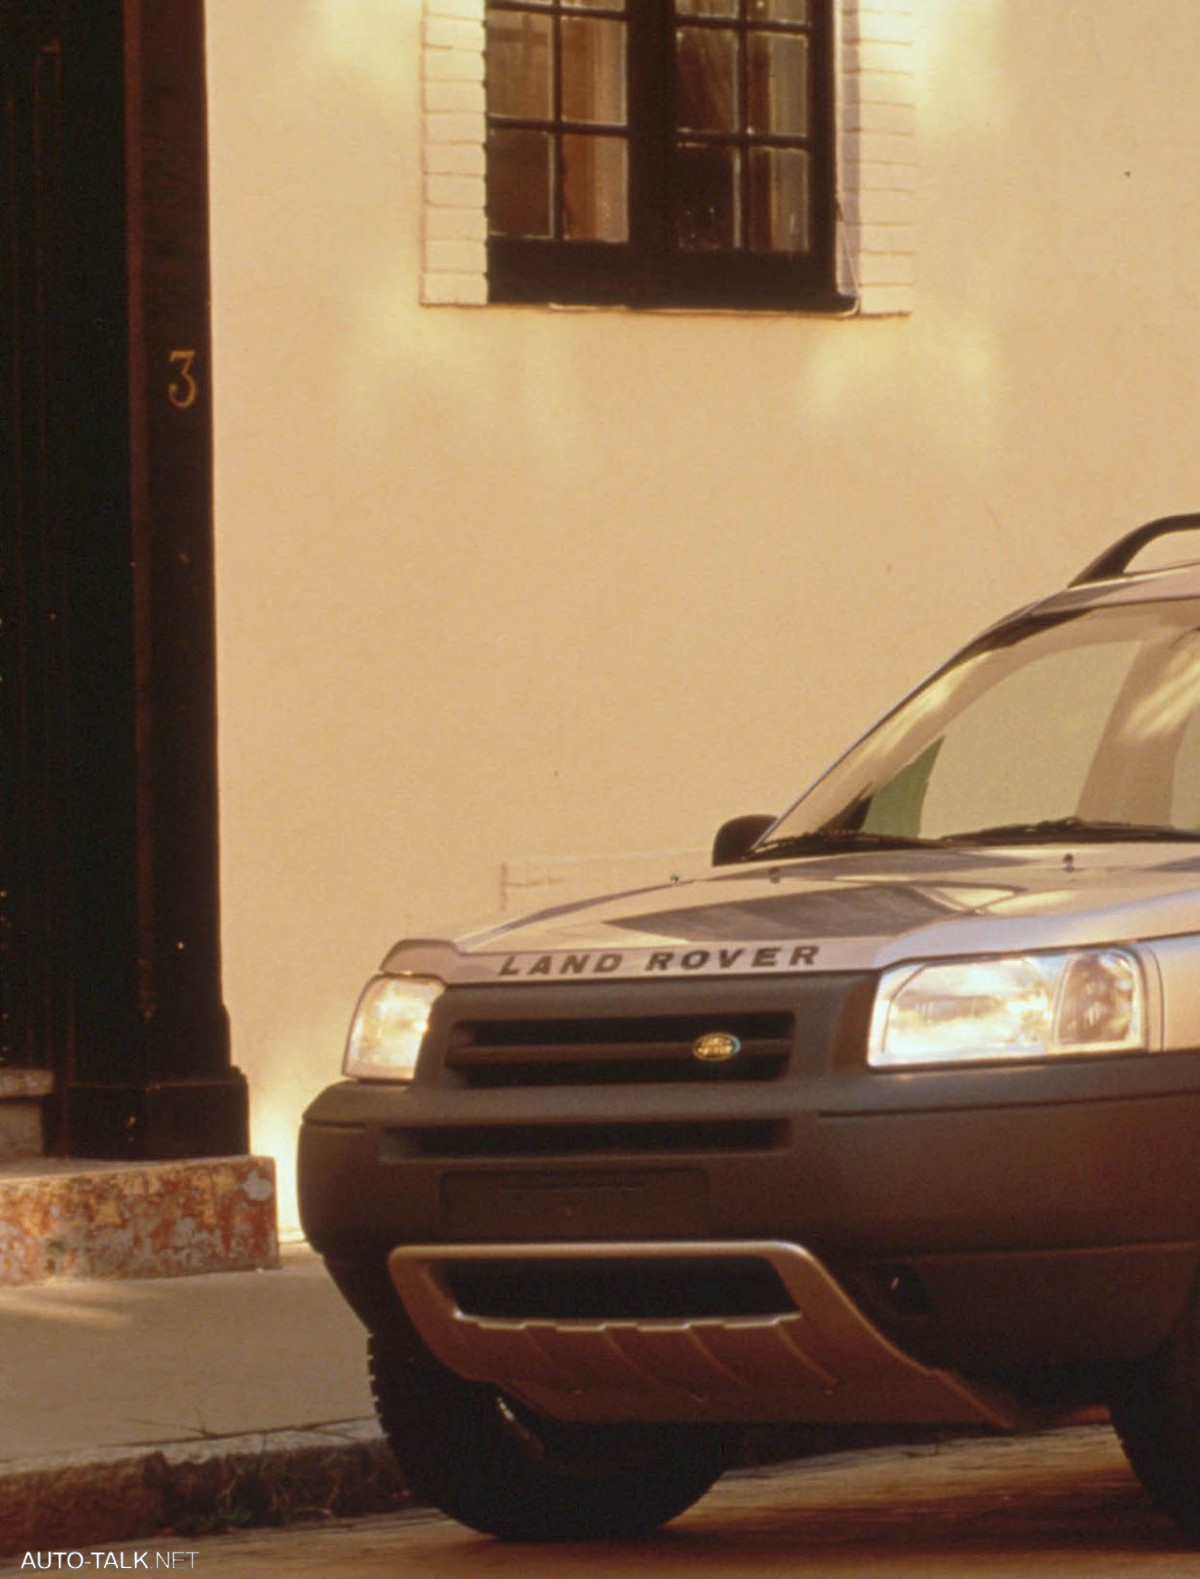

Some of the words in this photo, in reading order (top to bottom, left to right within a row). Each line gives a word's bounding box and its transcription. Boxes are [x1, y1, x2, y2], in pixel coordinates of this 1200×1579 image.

[167, 349, 197, 409] 3
[498, 952, 623, 977] LAND
[645, 945, 821, 972] ROVER
